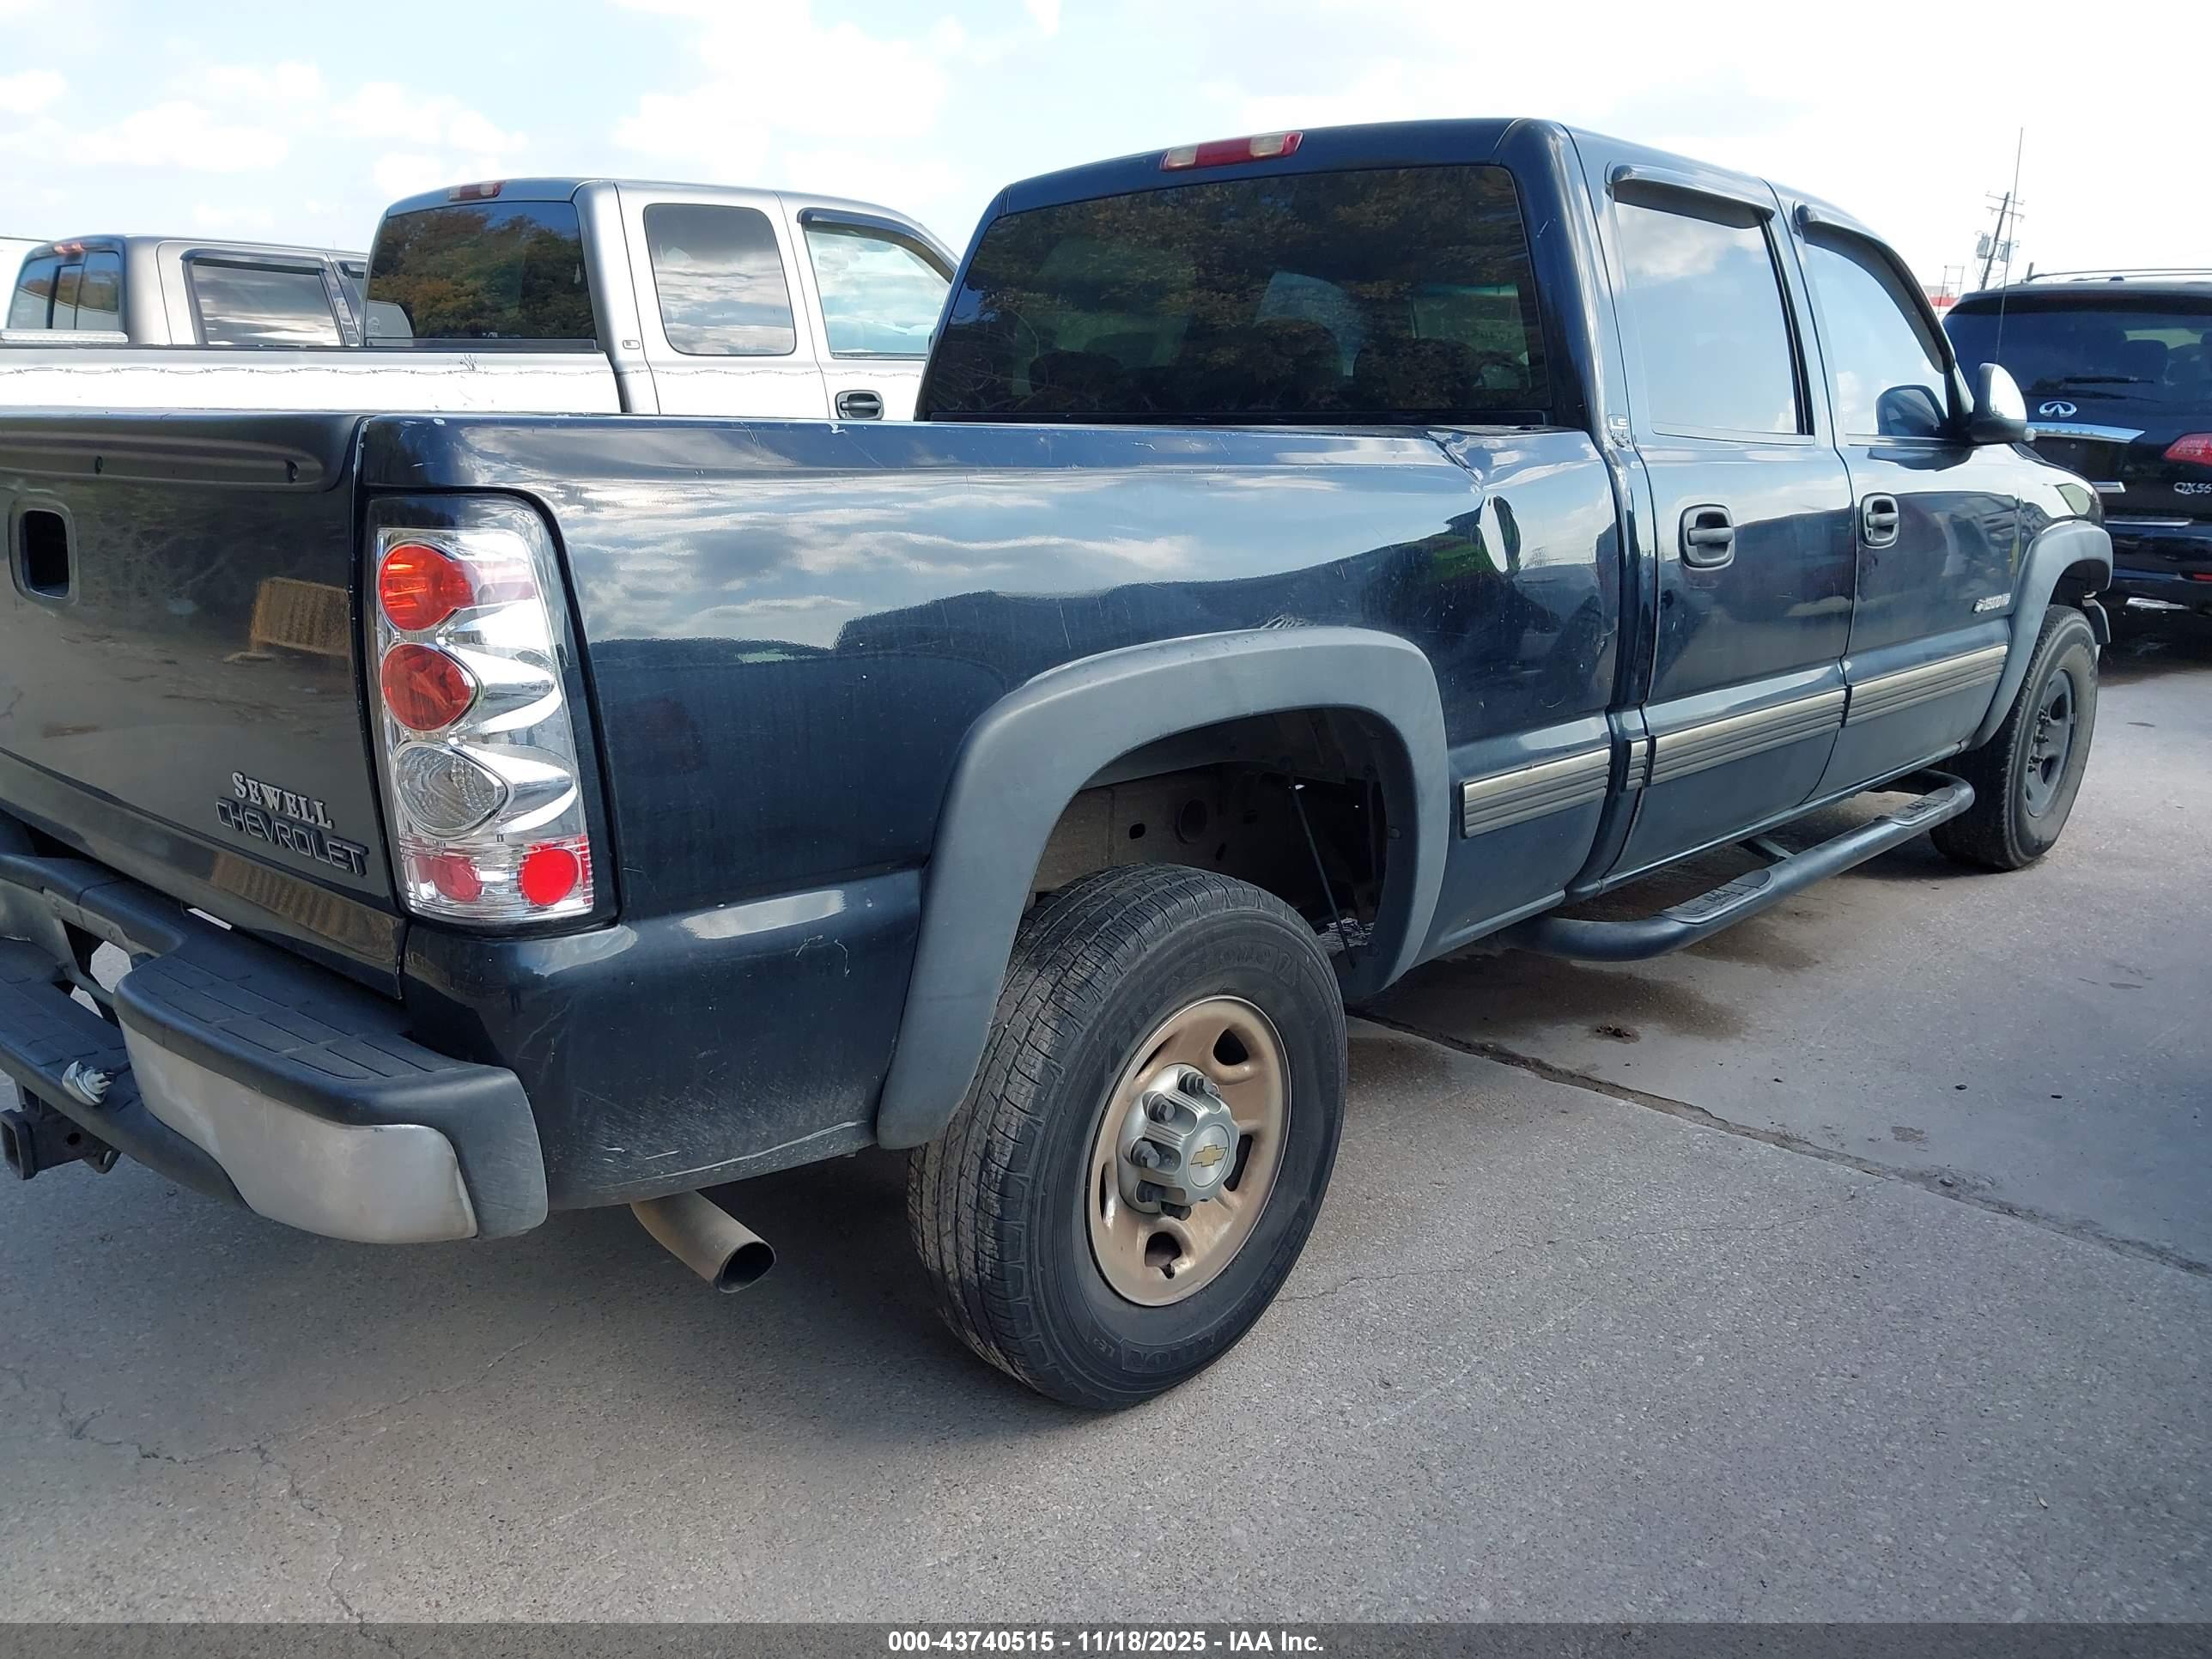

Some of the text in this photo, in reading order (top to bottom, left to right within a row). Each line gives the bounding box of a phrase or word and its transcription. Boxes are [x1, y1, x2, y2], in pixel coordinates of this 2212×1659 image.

[2173, 482, 2212, 495] QX56
[232, 771, 334, 830] SEWELL
[216, 799, 369, 877] CHEVROLET
